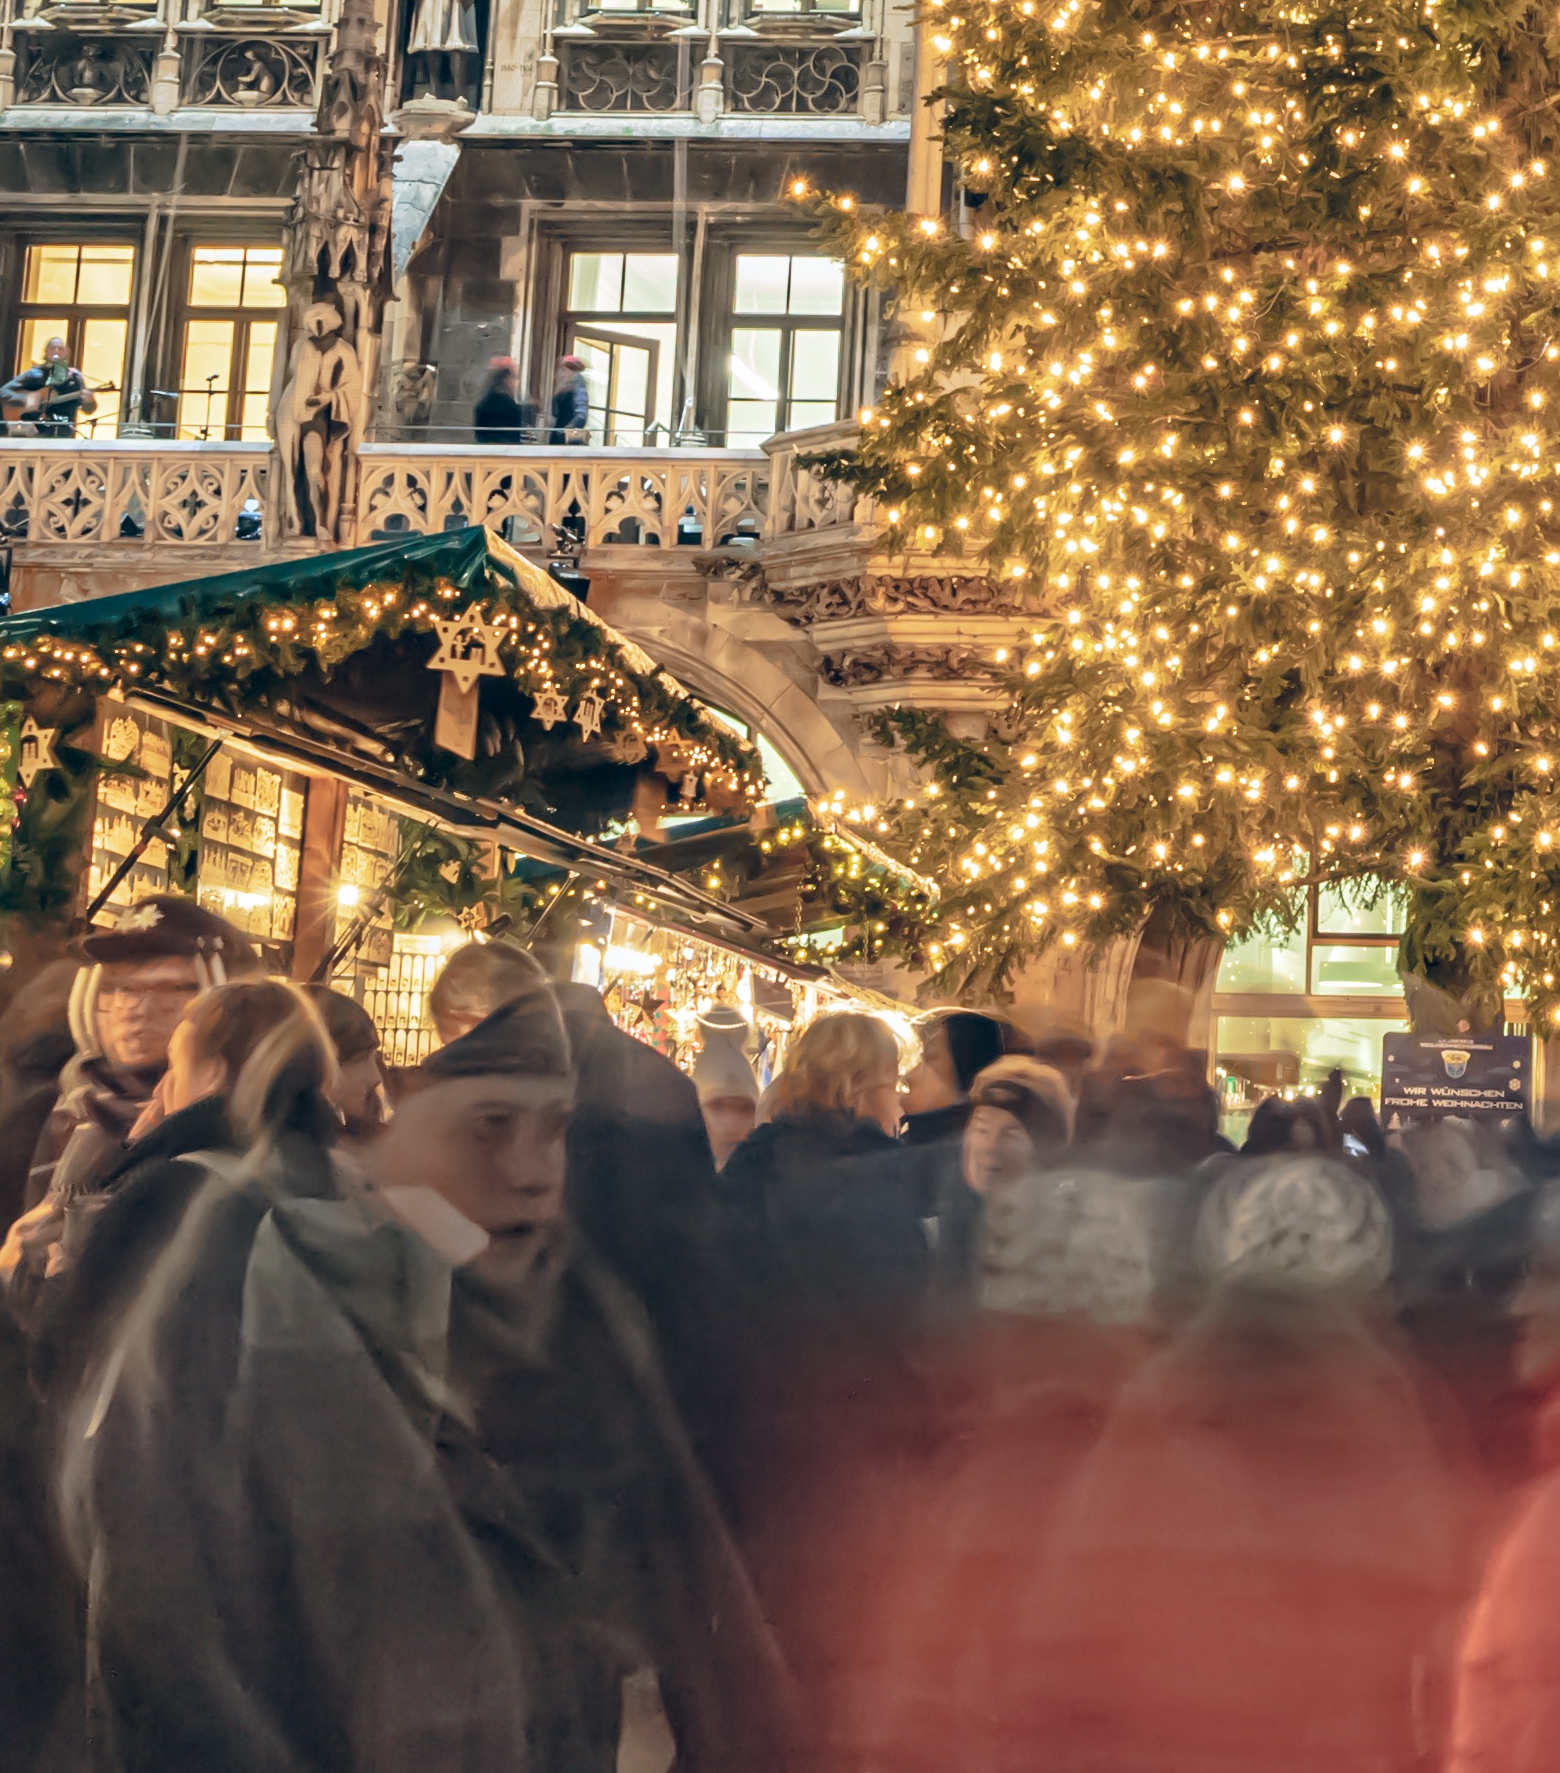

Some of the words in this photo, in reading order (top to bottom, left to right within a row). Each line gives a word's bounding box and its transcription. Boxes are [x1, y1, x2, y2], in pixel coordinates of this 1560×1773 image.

[1403, 1086, 1427, 1096] WIR
[1430, 1085, 1505, 1098] WÜNSCHEN
[1384, 1097, 1429, 1107] FROHE
[1431, 1099, 1524, 1110] WEIHNACHTEN
